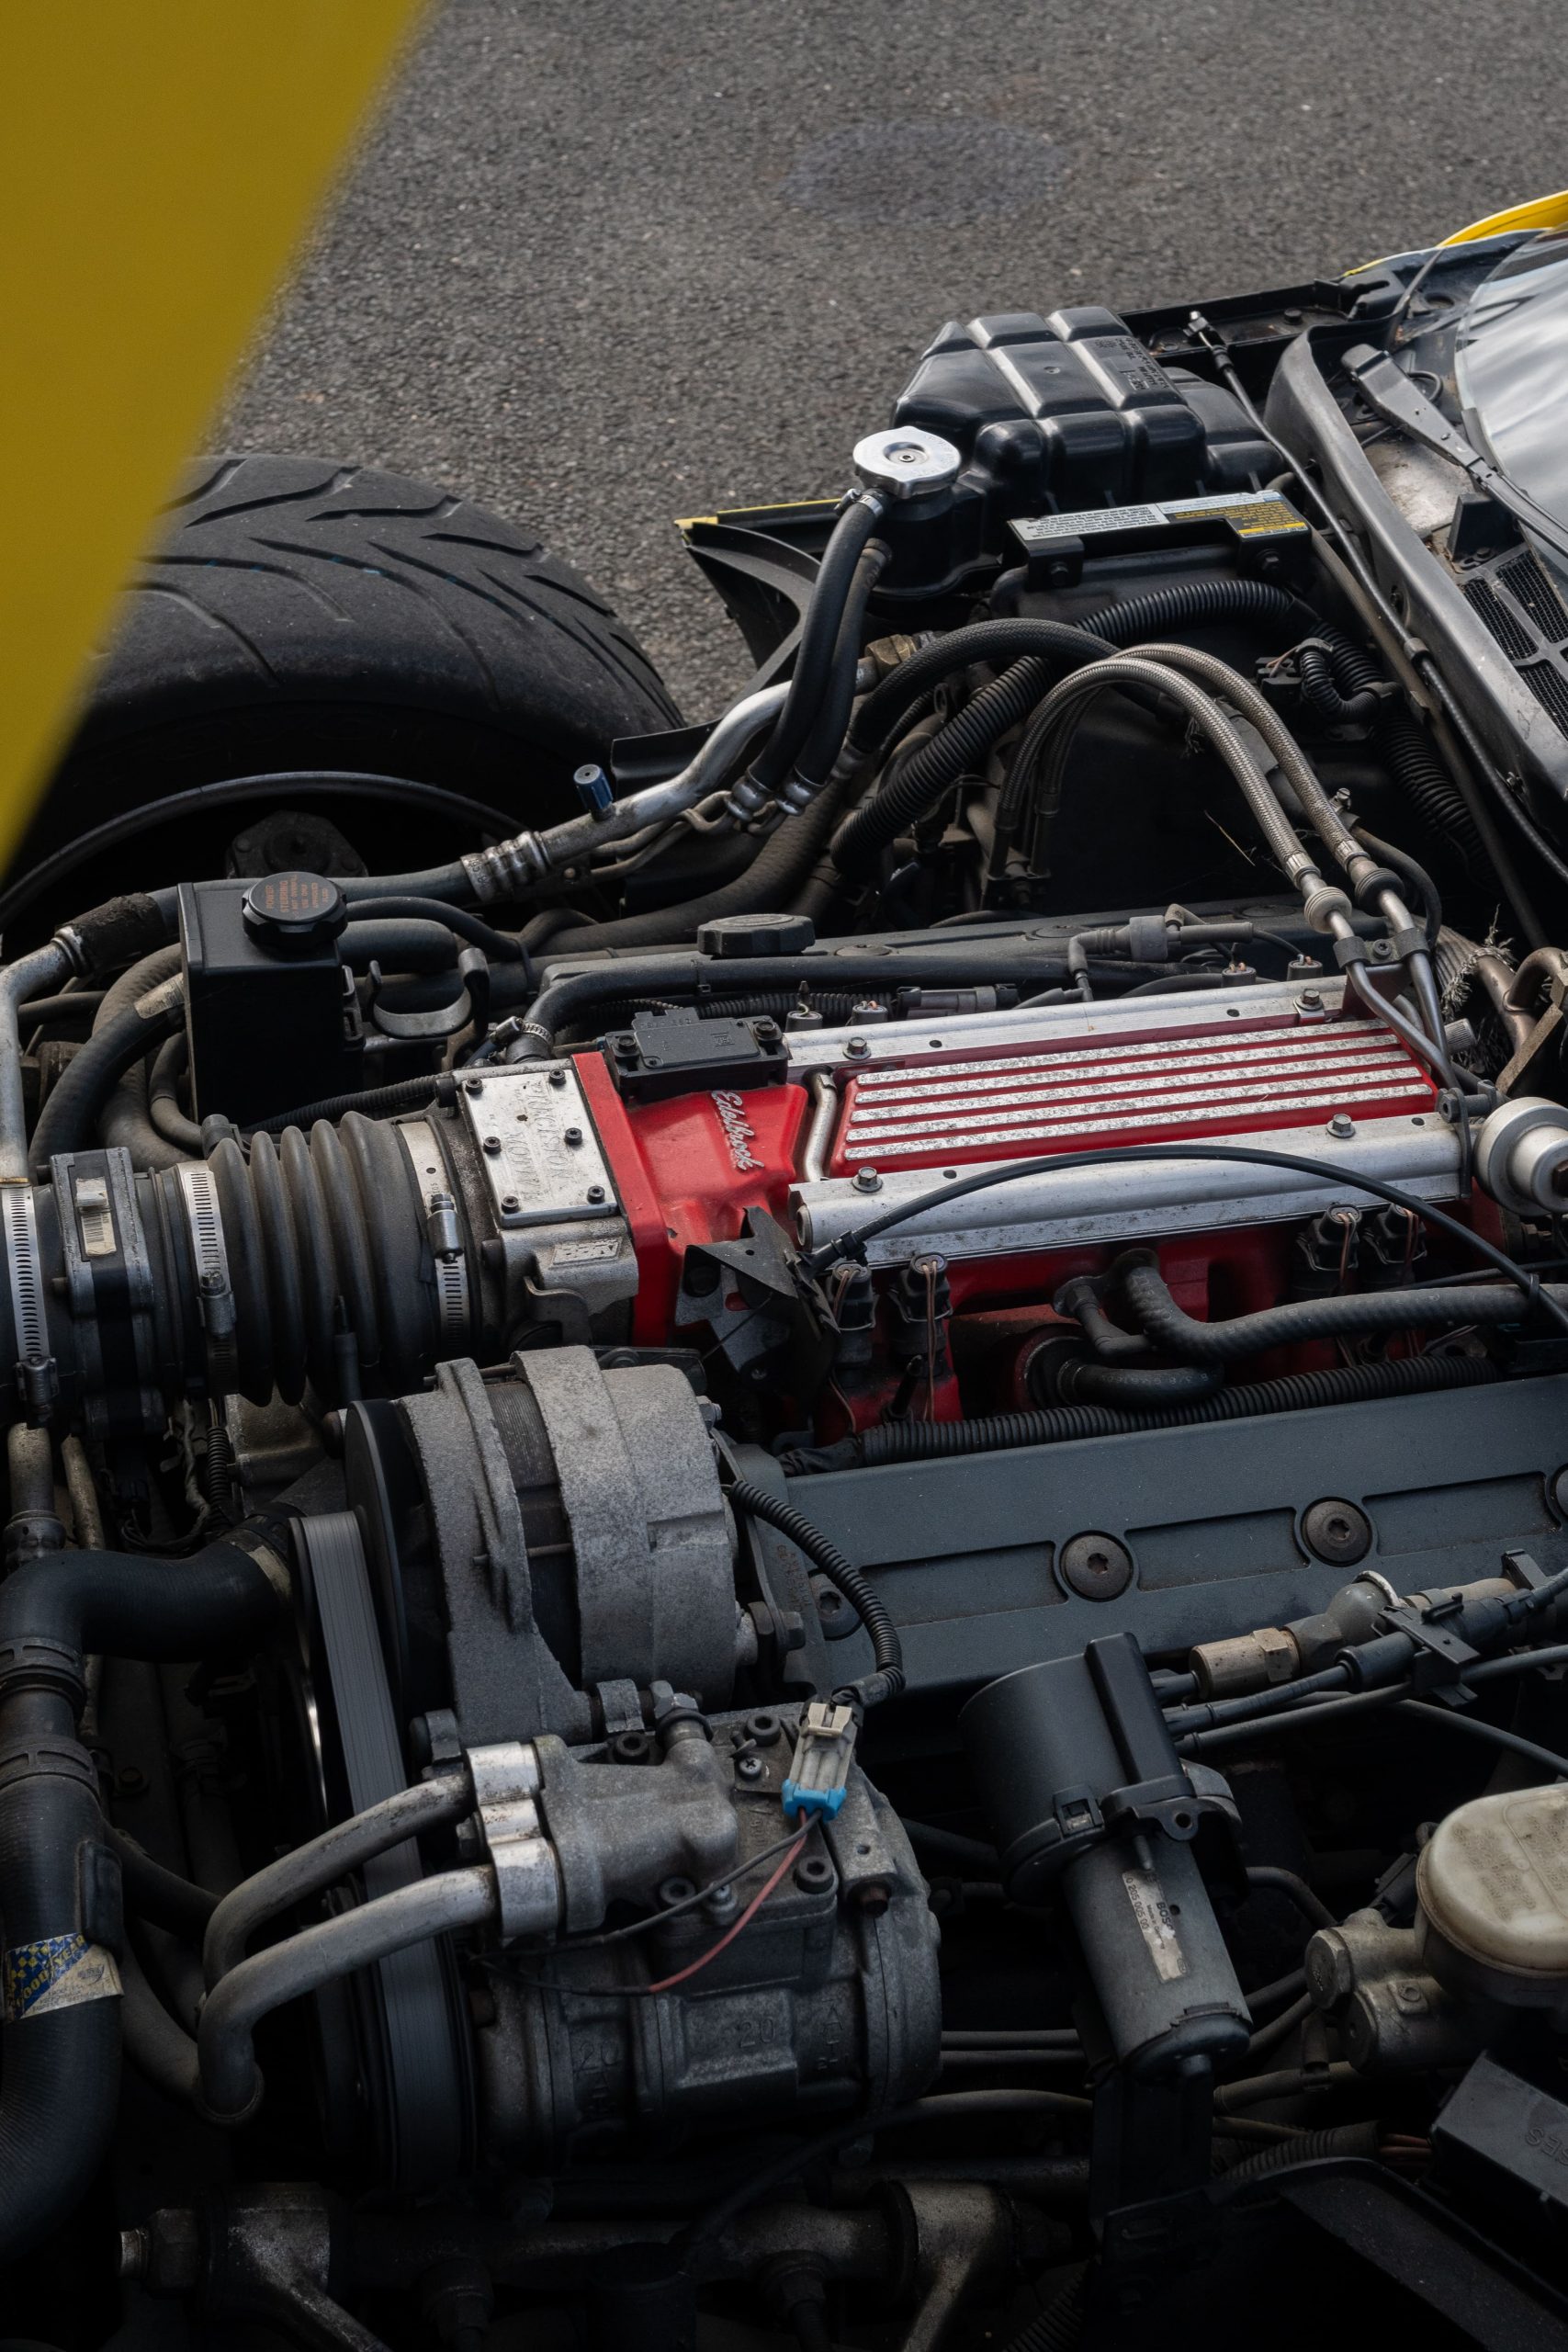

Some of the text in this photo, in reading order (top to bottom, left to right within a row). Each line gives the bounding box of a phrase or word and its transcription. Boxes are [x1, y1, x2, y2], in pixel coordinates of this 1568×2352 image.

[265, 885, 275, 910] POWER
[710, 1090, 765, 1171] Edelbrock
[1156, 1901, 1177, 1938] BOS
